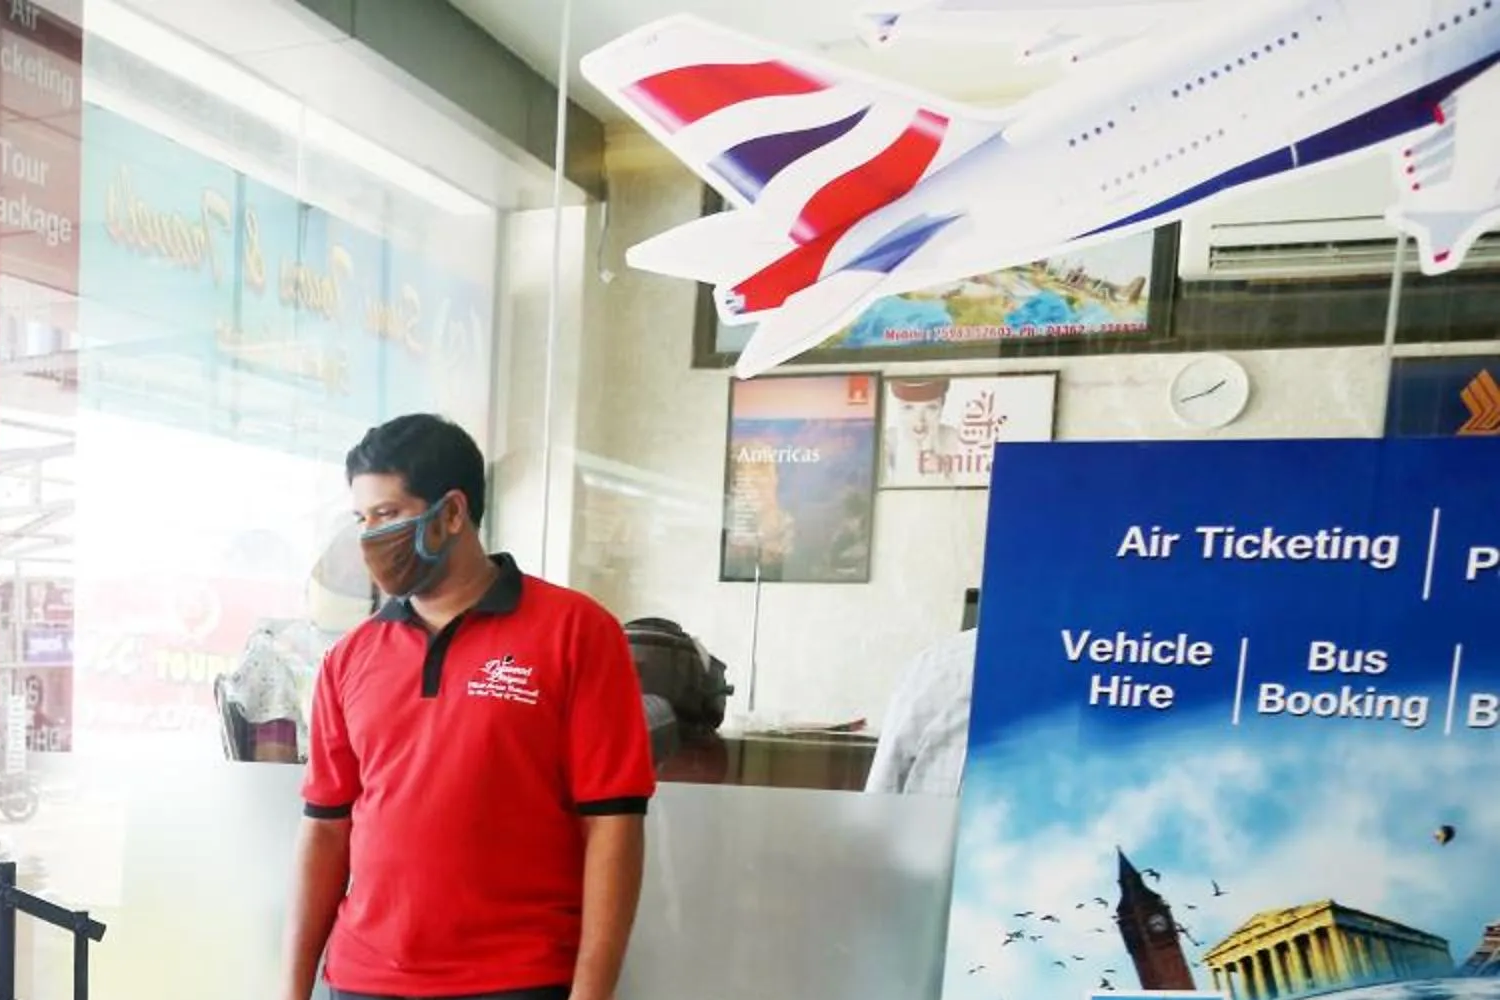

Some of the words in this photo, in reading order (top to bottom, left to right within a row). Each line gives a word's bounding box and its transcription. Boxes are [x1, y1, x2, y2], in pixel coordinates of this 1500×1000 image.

[737, 446, 821, 463] Americas
[1116, 525, 1180, 558] Air
[1195, 526, 1400, 568] Ticketing
[1061, 629, 1214, 666] Vehicle
[1308, 640, 1389, 674] Bus
[1088, 674, 1175, 709] Hire
[1257, 682, 1429, 728] Booking
